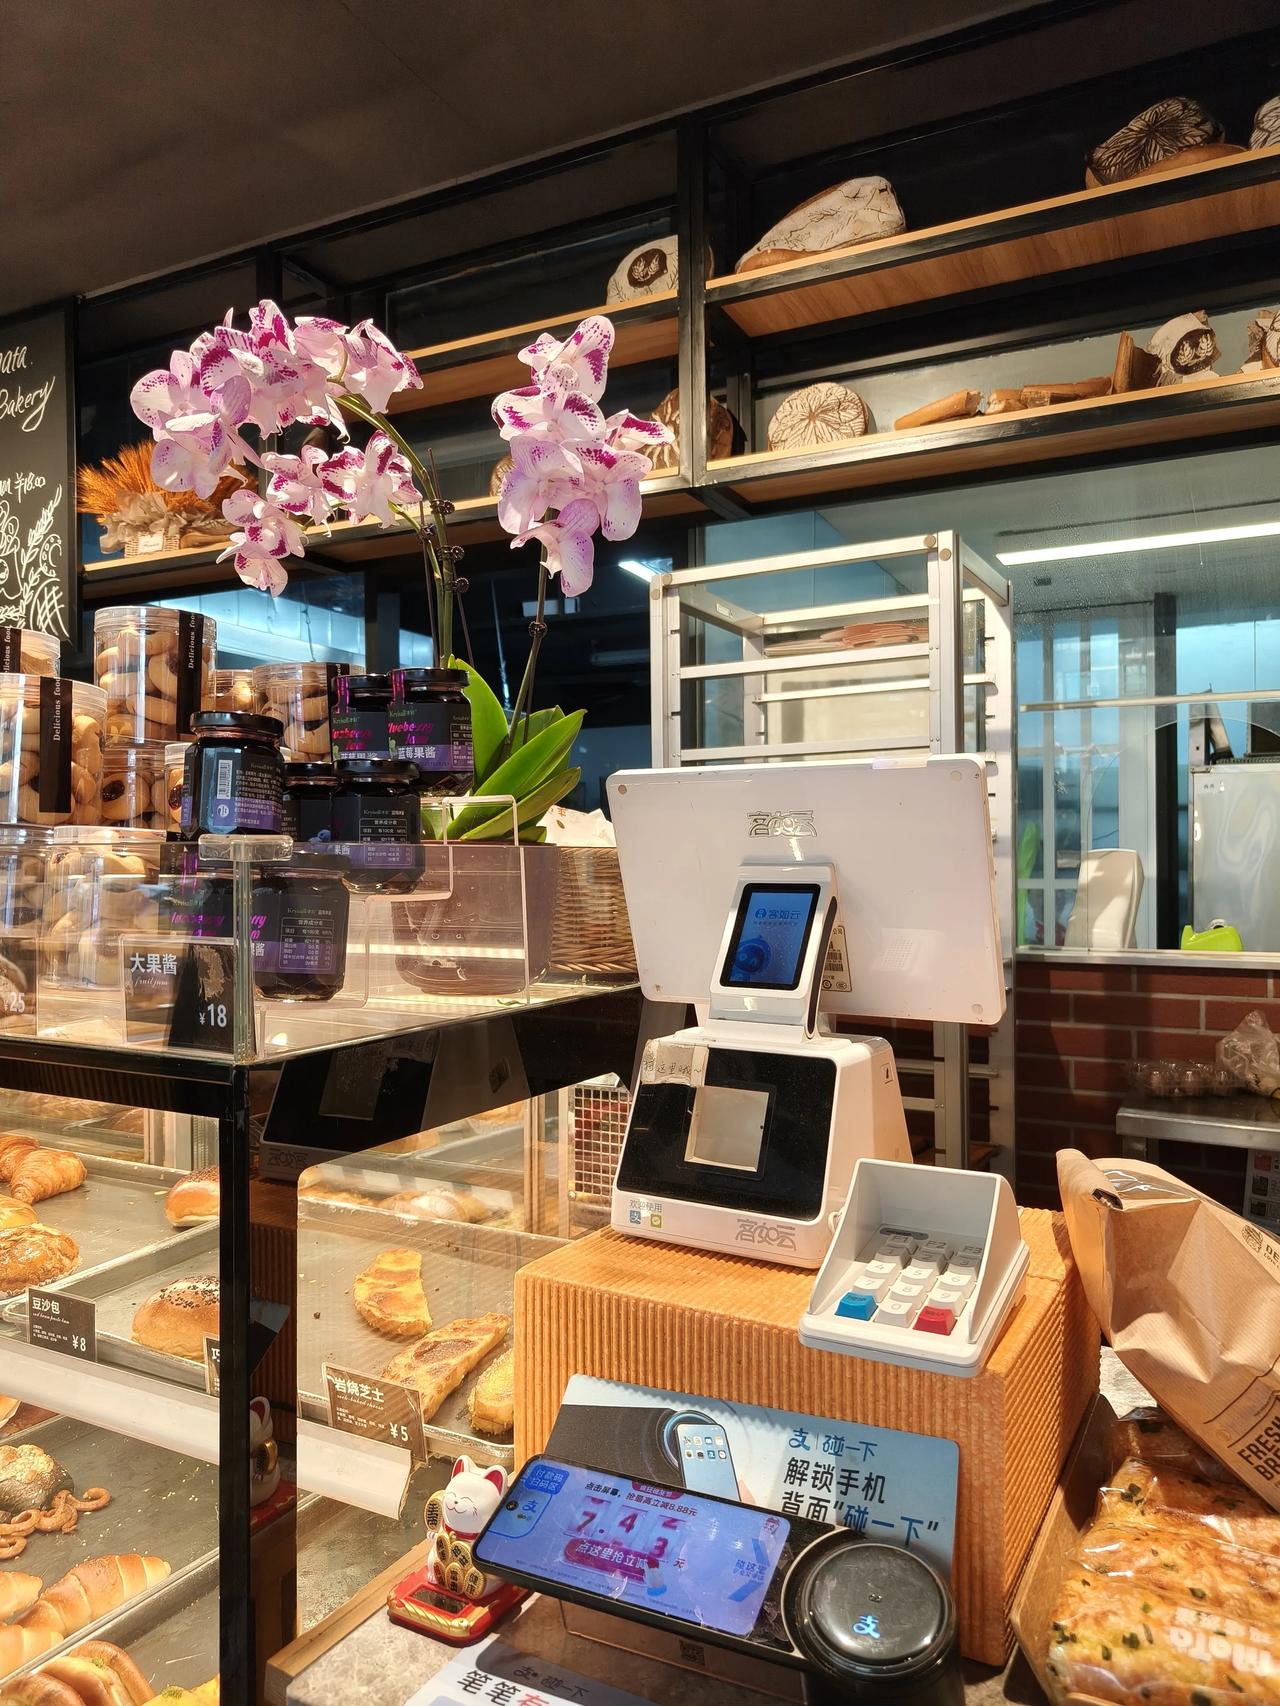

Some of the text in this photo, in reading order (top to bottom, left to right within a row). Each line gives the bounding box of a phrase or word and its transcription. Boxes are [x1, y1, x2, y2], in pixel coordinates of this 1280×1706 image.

[0, 346, 33, 374] ata.
[53, 699, 61, 742] Delicious
[397, 746, 436, 759] 蓝莓果酱
[768, 910, 801, 920] 客如云
[130, 952, 178, 976] 大果酱
[199, 1003, 227, 1028] ¥18
[629, 1199, 663, 1213] 欢迎使用
[926, 1240, 947, 1249] F2
[32, 1297, 60, 1315] 豆沙包
[72, 1334, 87, 1352] ¥8
[334, 1377, 384, 1403] 岩烧芝士
[389, 1422, 409, 1442] ¥5
[822, 1434, 878, 1462] 碰一下
[783, 1456, 886, 1504] 解锁手机
